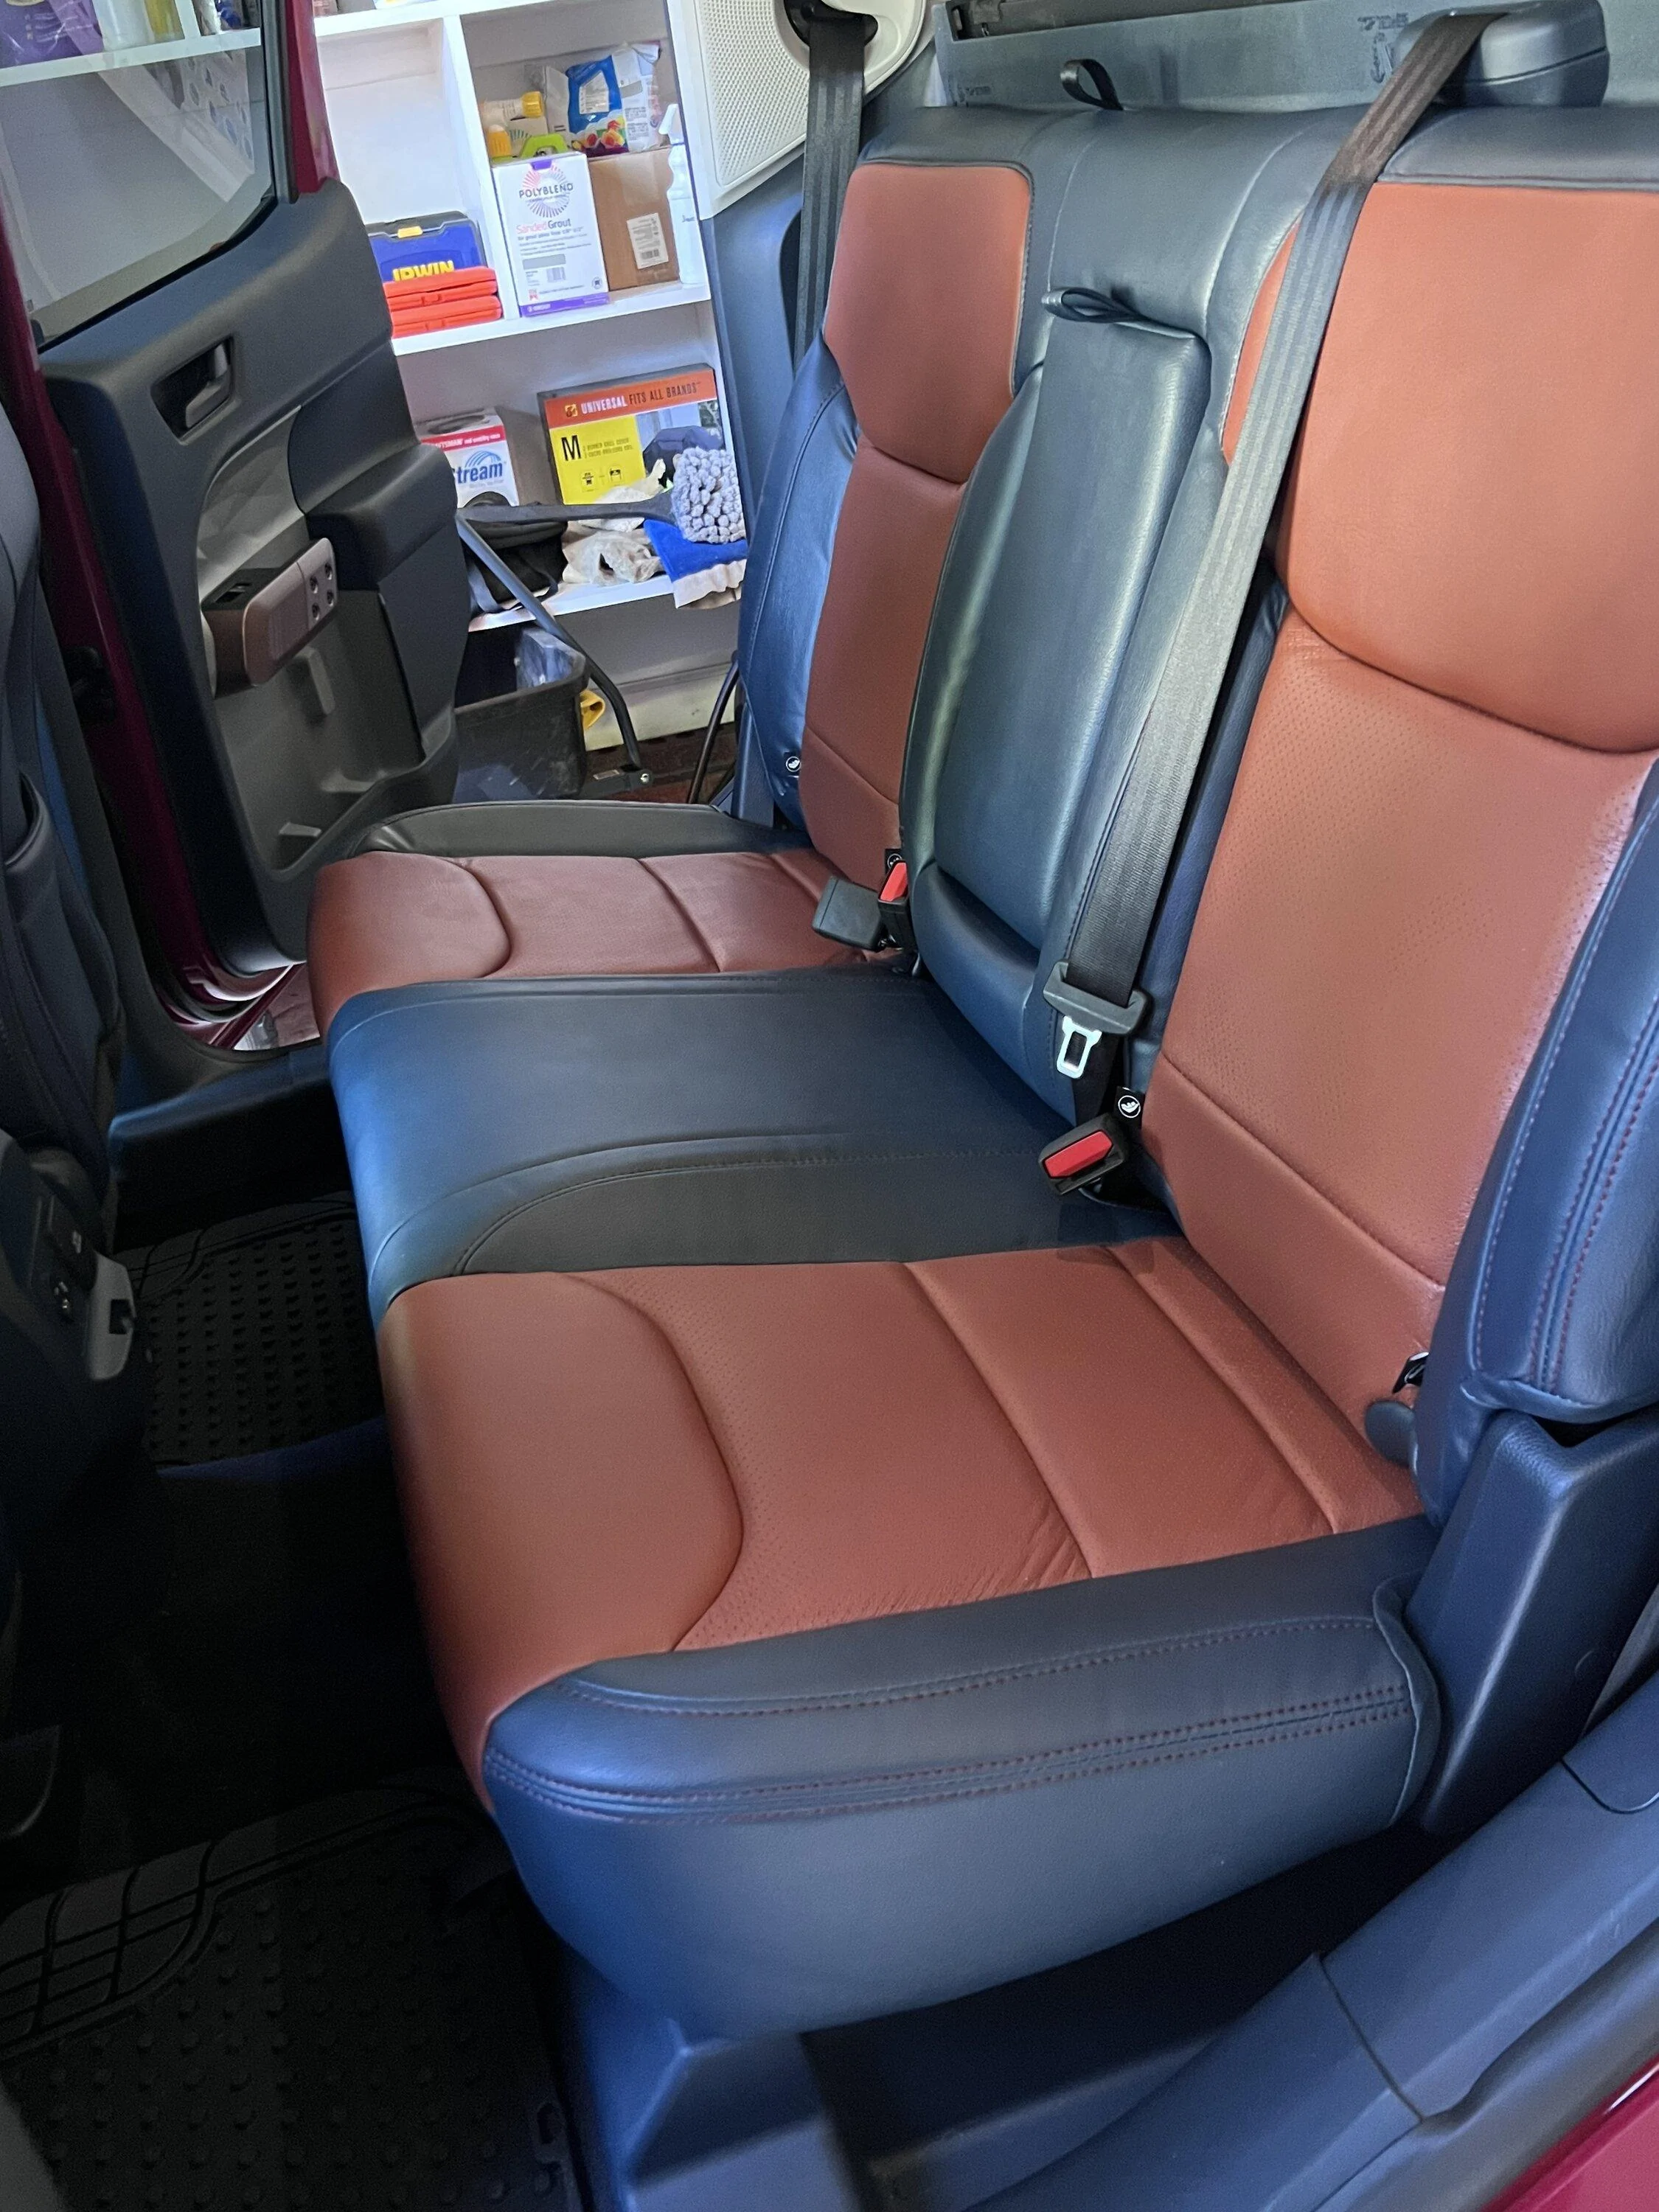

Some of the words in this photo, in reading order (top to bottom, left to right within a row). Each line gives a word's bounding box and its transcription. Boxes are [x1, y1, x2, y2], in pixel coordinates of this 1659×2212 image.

[519, 183, 574, 198] POLYBLEND
[548, 218, 571, 229] Grout
[580, 395, 628, 414] UNIVERSAL
[629, 393, 647, 405] FITS
[650, 389, 664, 400] ALL
[561, 434, 582, 462] M
[452, 463, 503, 484] tream
